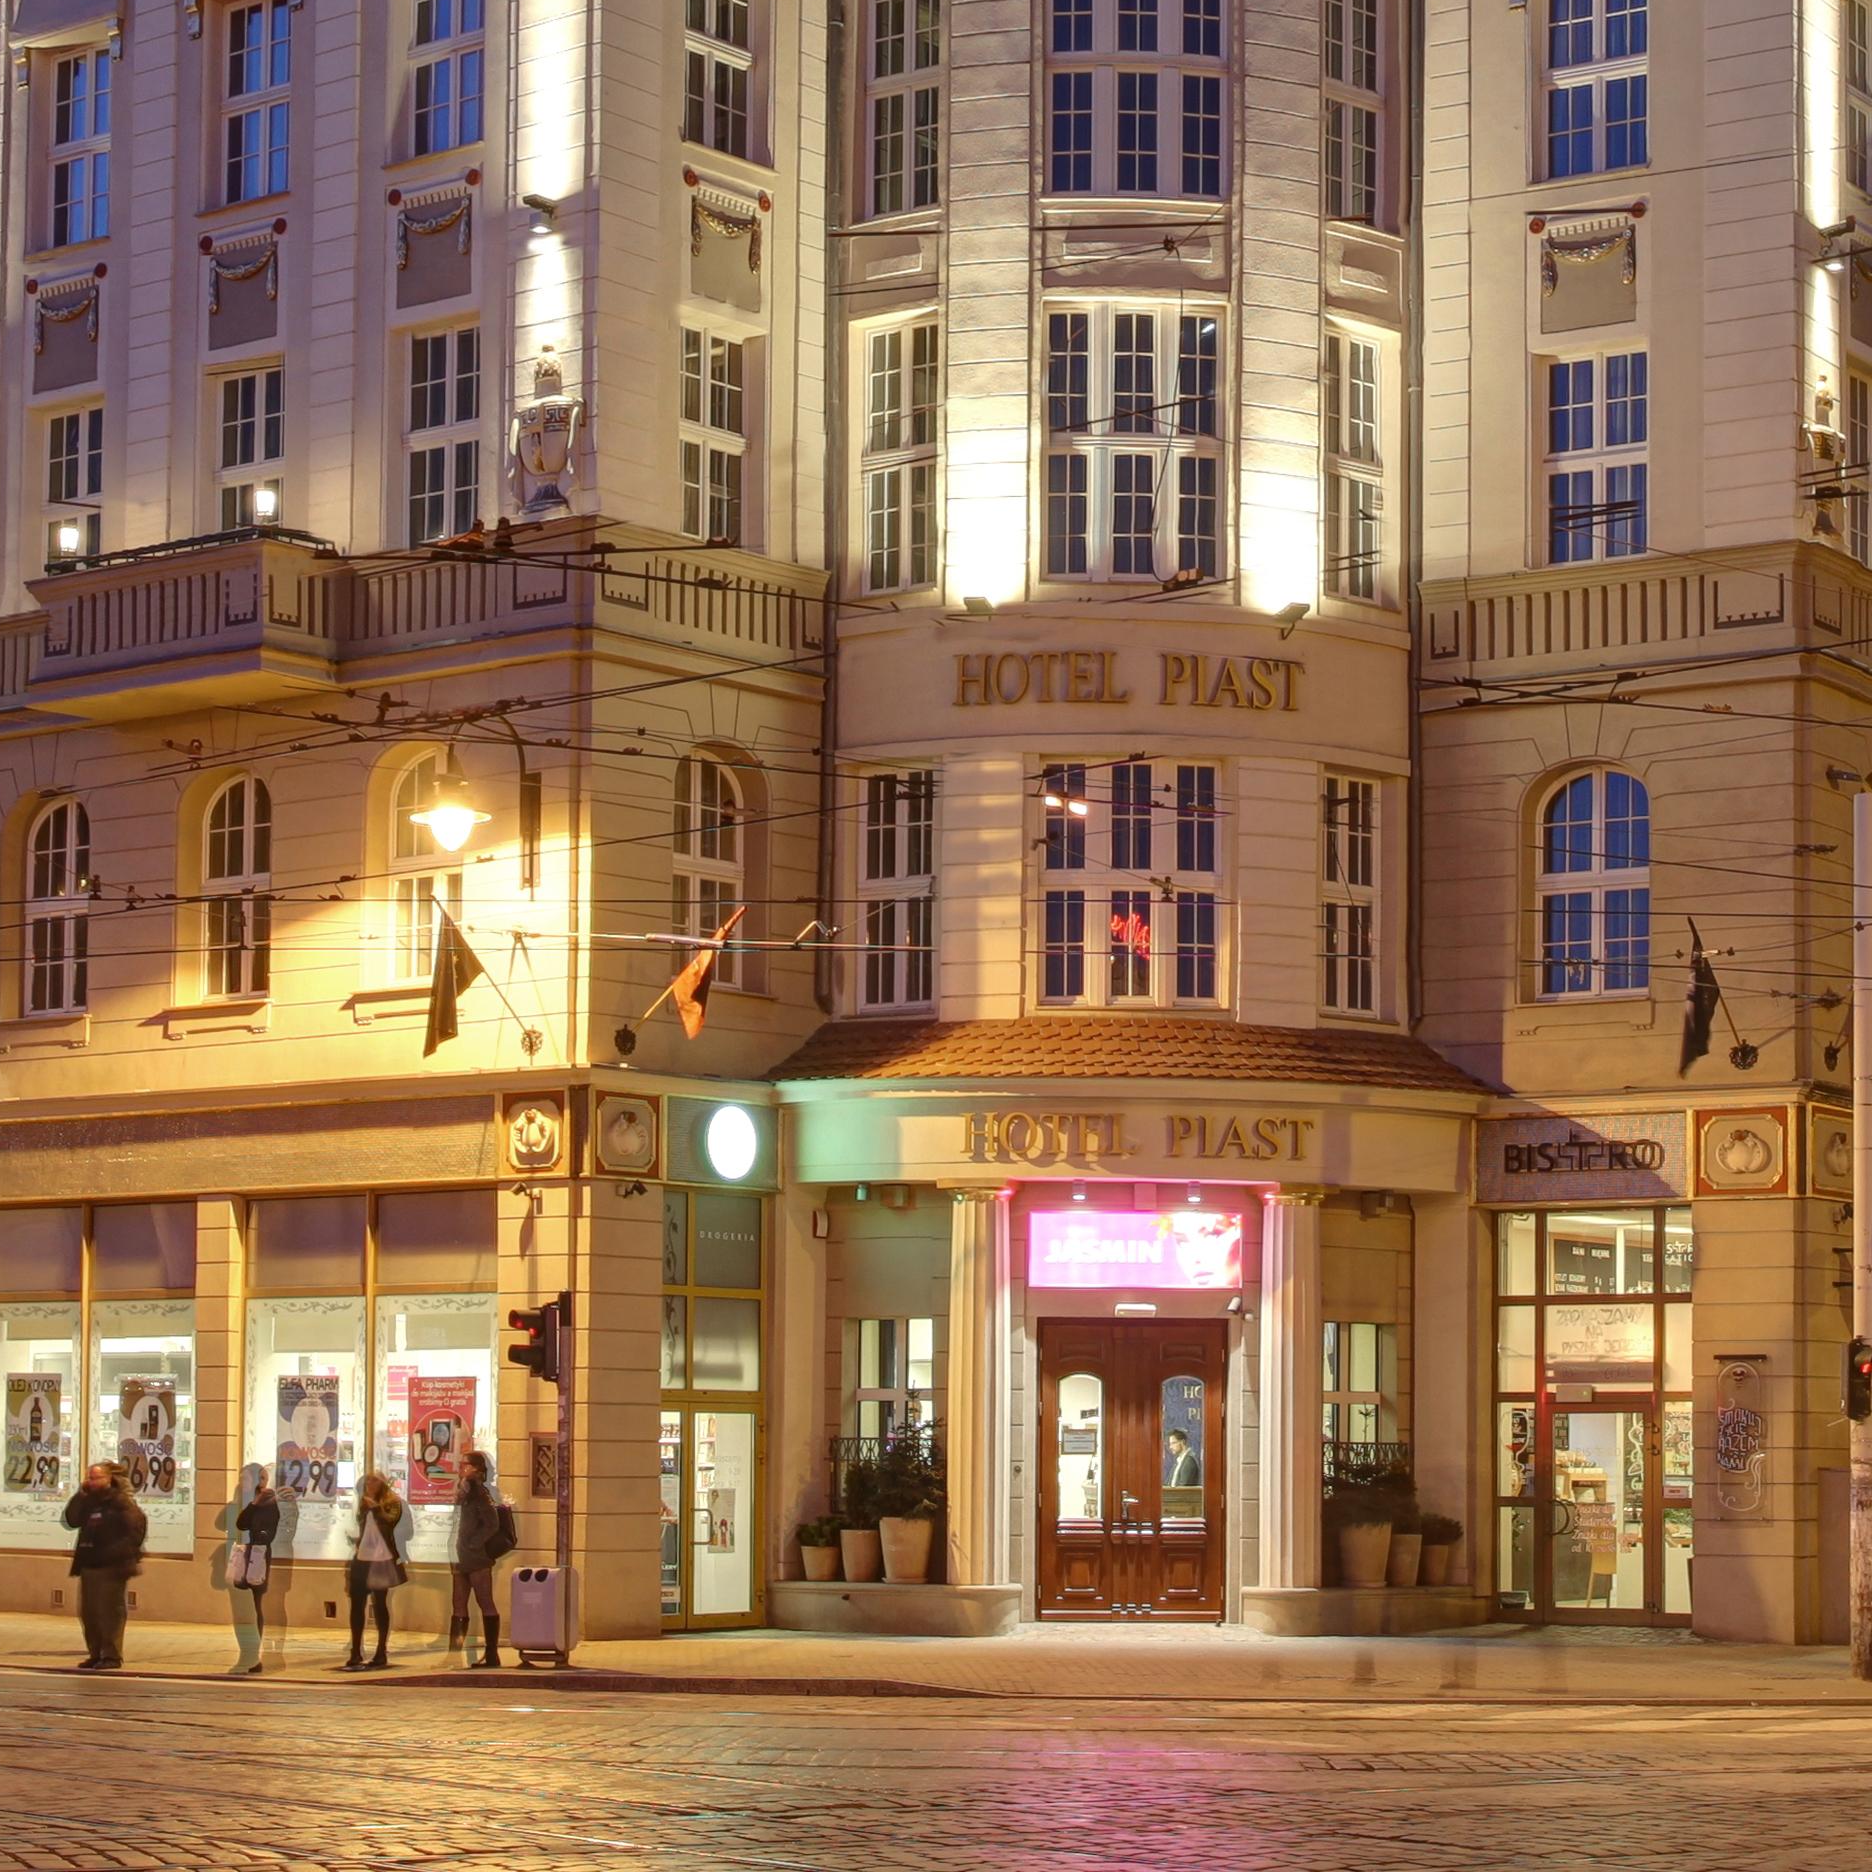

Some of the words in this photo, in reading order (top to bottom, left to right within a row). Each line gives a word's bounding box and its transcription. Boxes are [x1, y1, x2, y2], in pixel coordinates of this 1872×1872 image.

[953, 650, 1129, 707] HOTEL
[1159, 653, 1306, 712] PIAST
[962, 1111, 1135, 1158] HOTEL
[1166, 1114, 1314, 1161] PIAST
[1504, 1138, 1658, 1173] BISTRO
[699, 1231, 755, 1241] DROGERIA
[1044, 1238, 1164, 1264] JASMIN
[279, 1378, 303, 1390] ELFA
[305, 1378, 339, 1391] PHARM
[8, 1455, 60, 1488] 22,99
